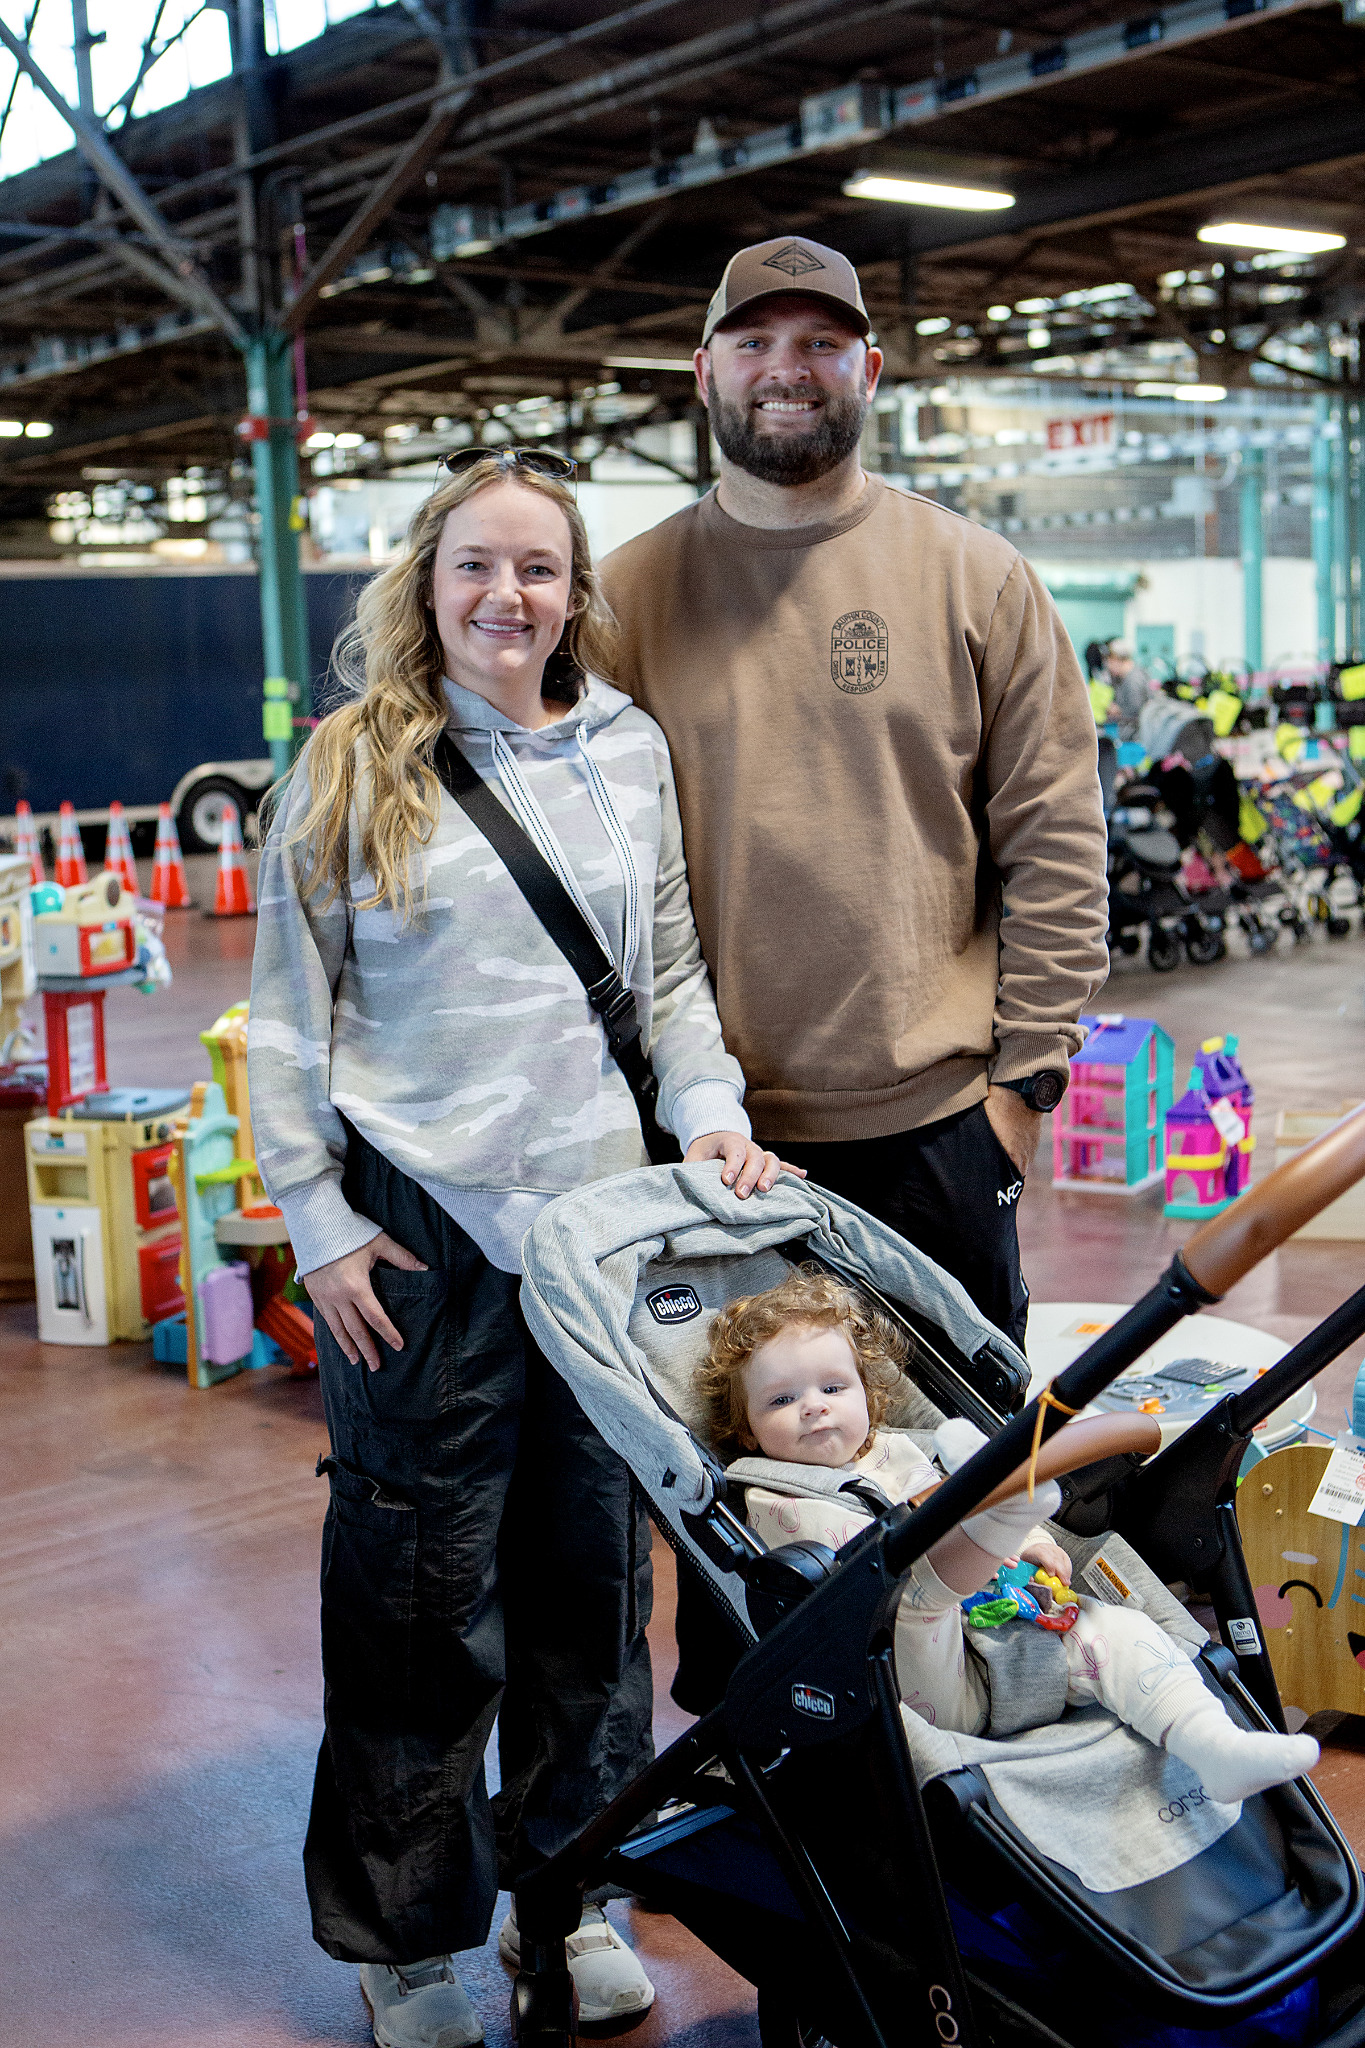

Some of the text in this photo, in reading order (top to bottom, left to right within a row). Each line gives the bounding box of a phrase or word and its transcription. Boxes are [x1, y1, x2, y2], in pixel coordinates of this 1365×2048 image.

[1046, 413, 1114, 450] EXIT
[834, 611, 886, 631] DAUPHIN COUNTY
[834, 639, 886, 650] POLICE
[841, 683, 876, 693] RESPONSE
[656, 1292, 696, 1316] chicco
[1101, 1564, 1129, 1597] WARNING
[795, 1688, 831, 1716] chicco
